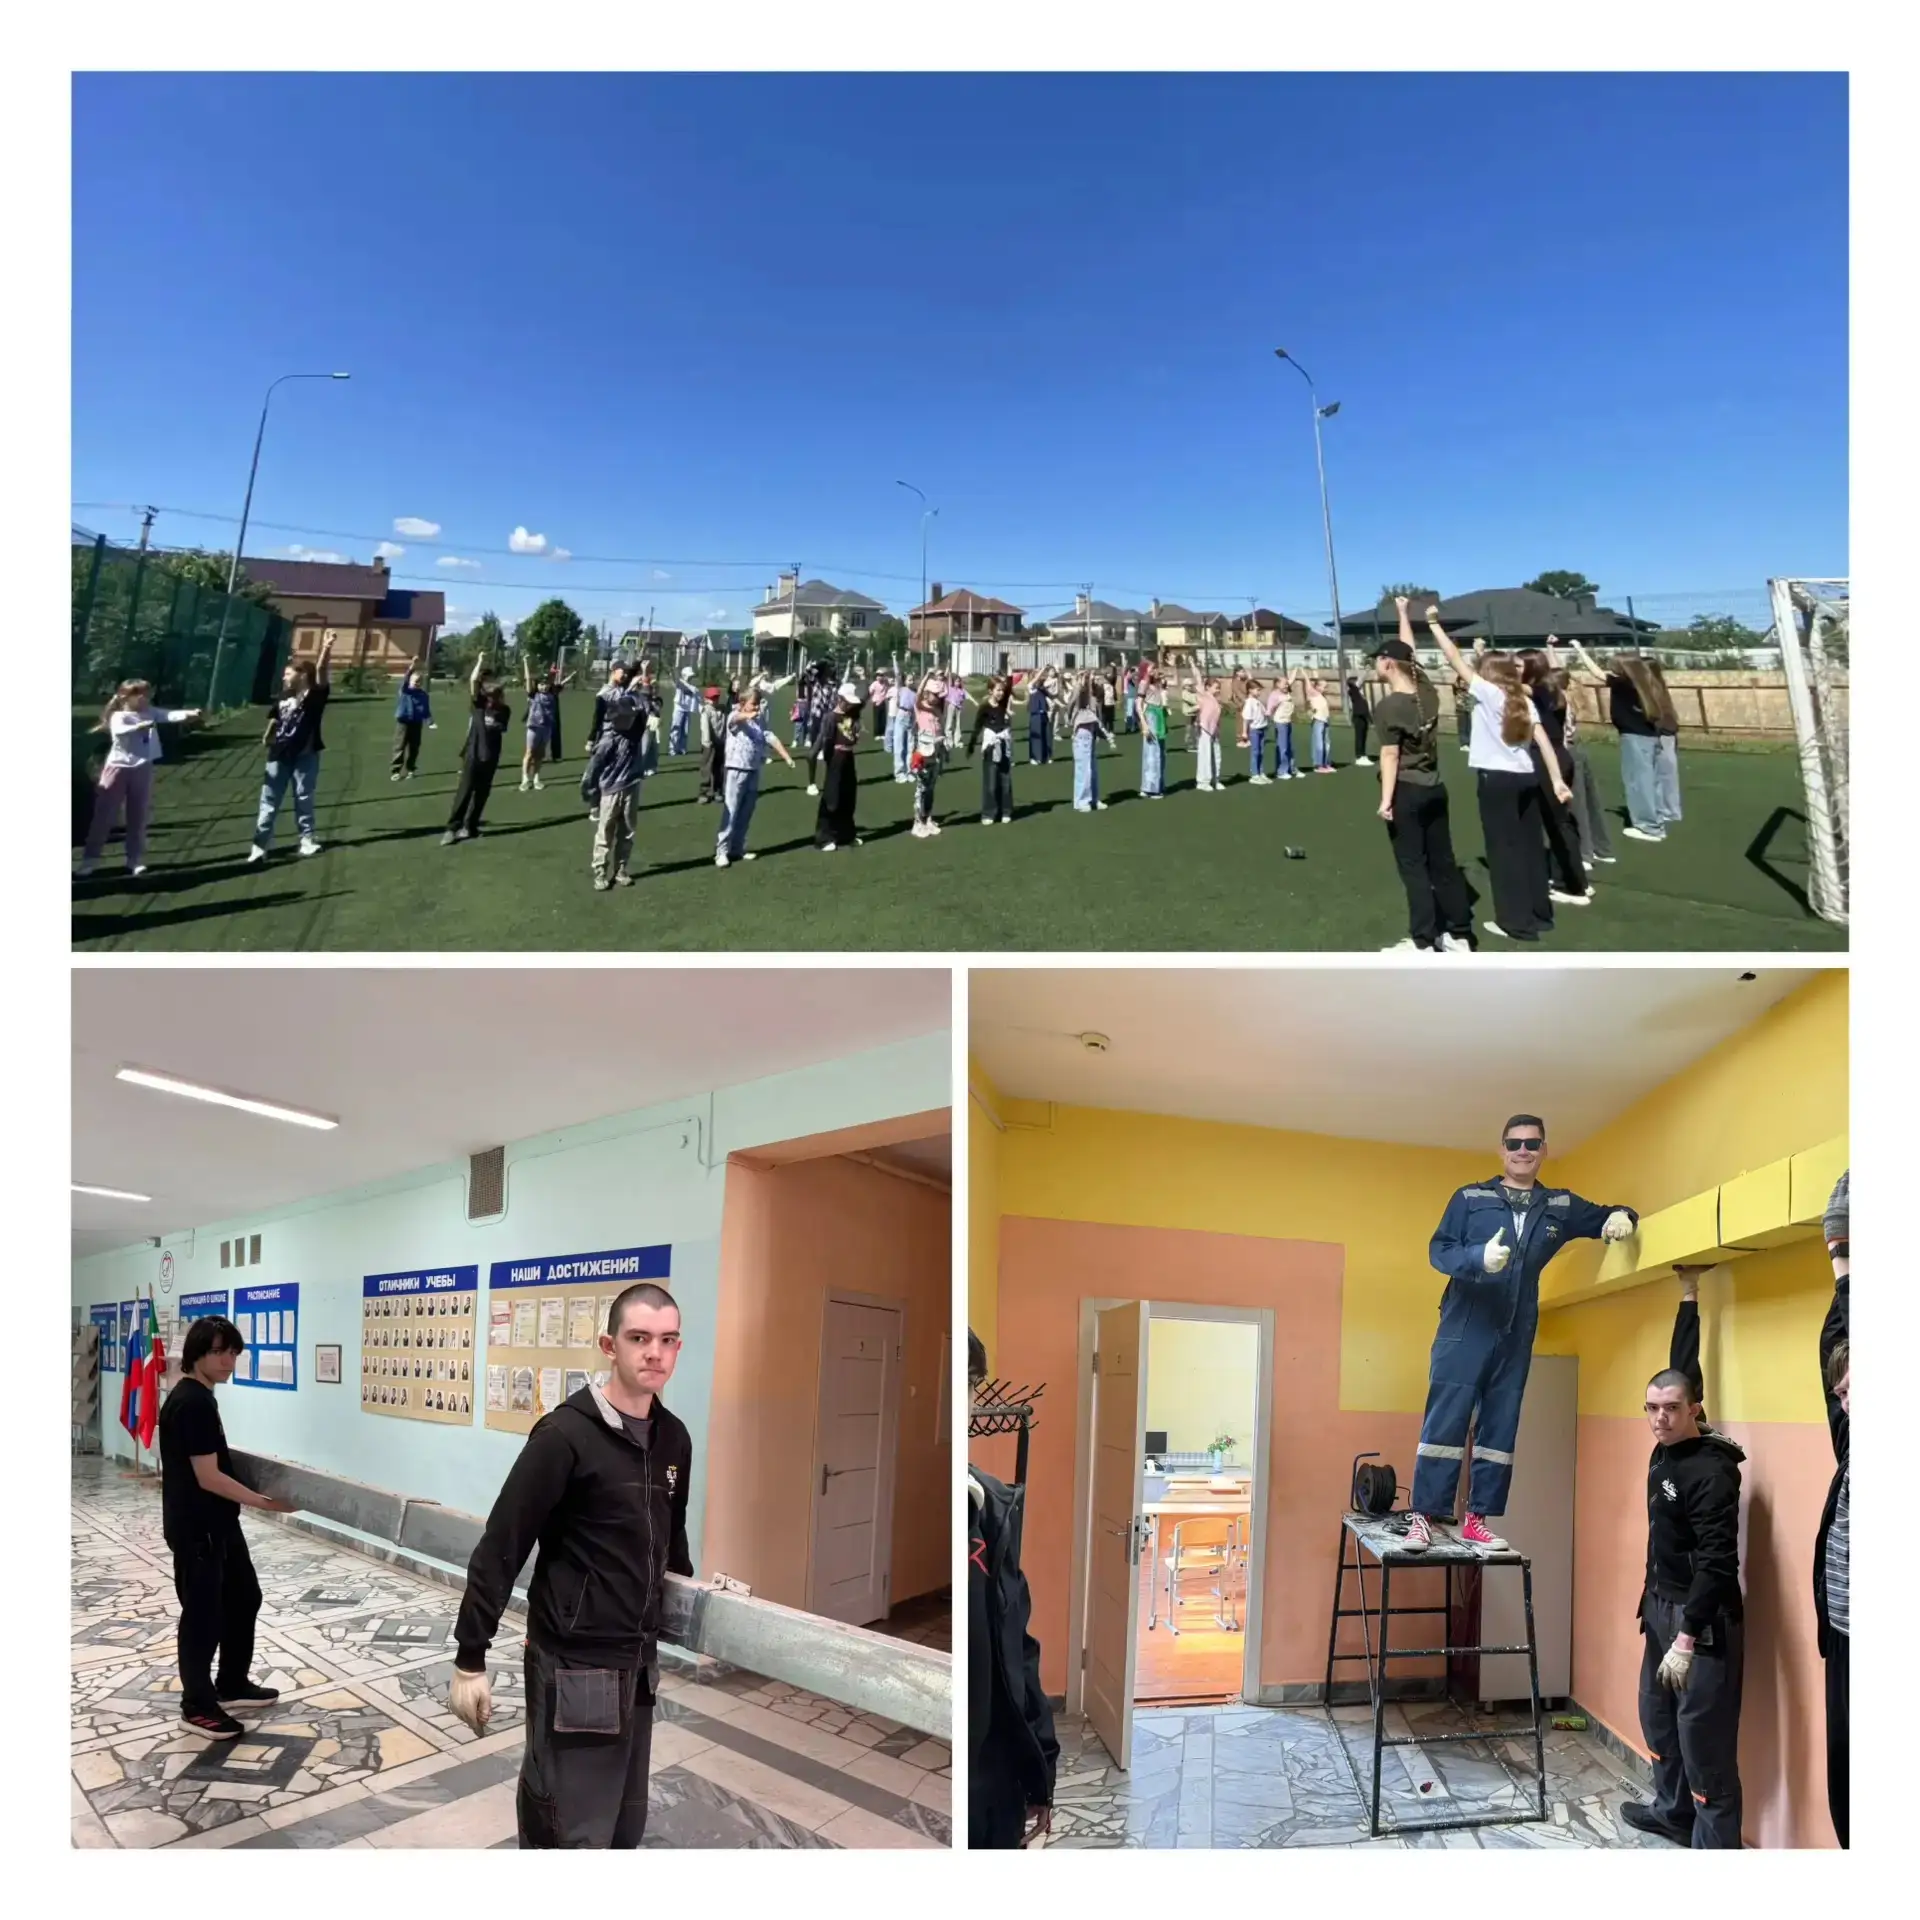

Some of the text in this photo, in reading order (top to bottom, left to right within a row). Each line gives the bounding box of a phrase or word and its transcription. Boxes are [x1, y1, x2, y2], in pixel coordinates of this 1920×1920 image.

[511, 1256, 639, 1282] НАШИ ДОСТИЖЕНИЯ
[379, 1274, 456, 1292] ОТЛИЧНИКИ УЧЕБЫ
[247, 1288, 281, 1301] РАСПИСАНИЕ
